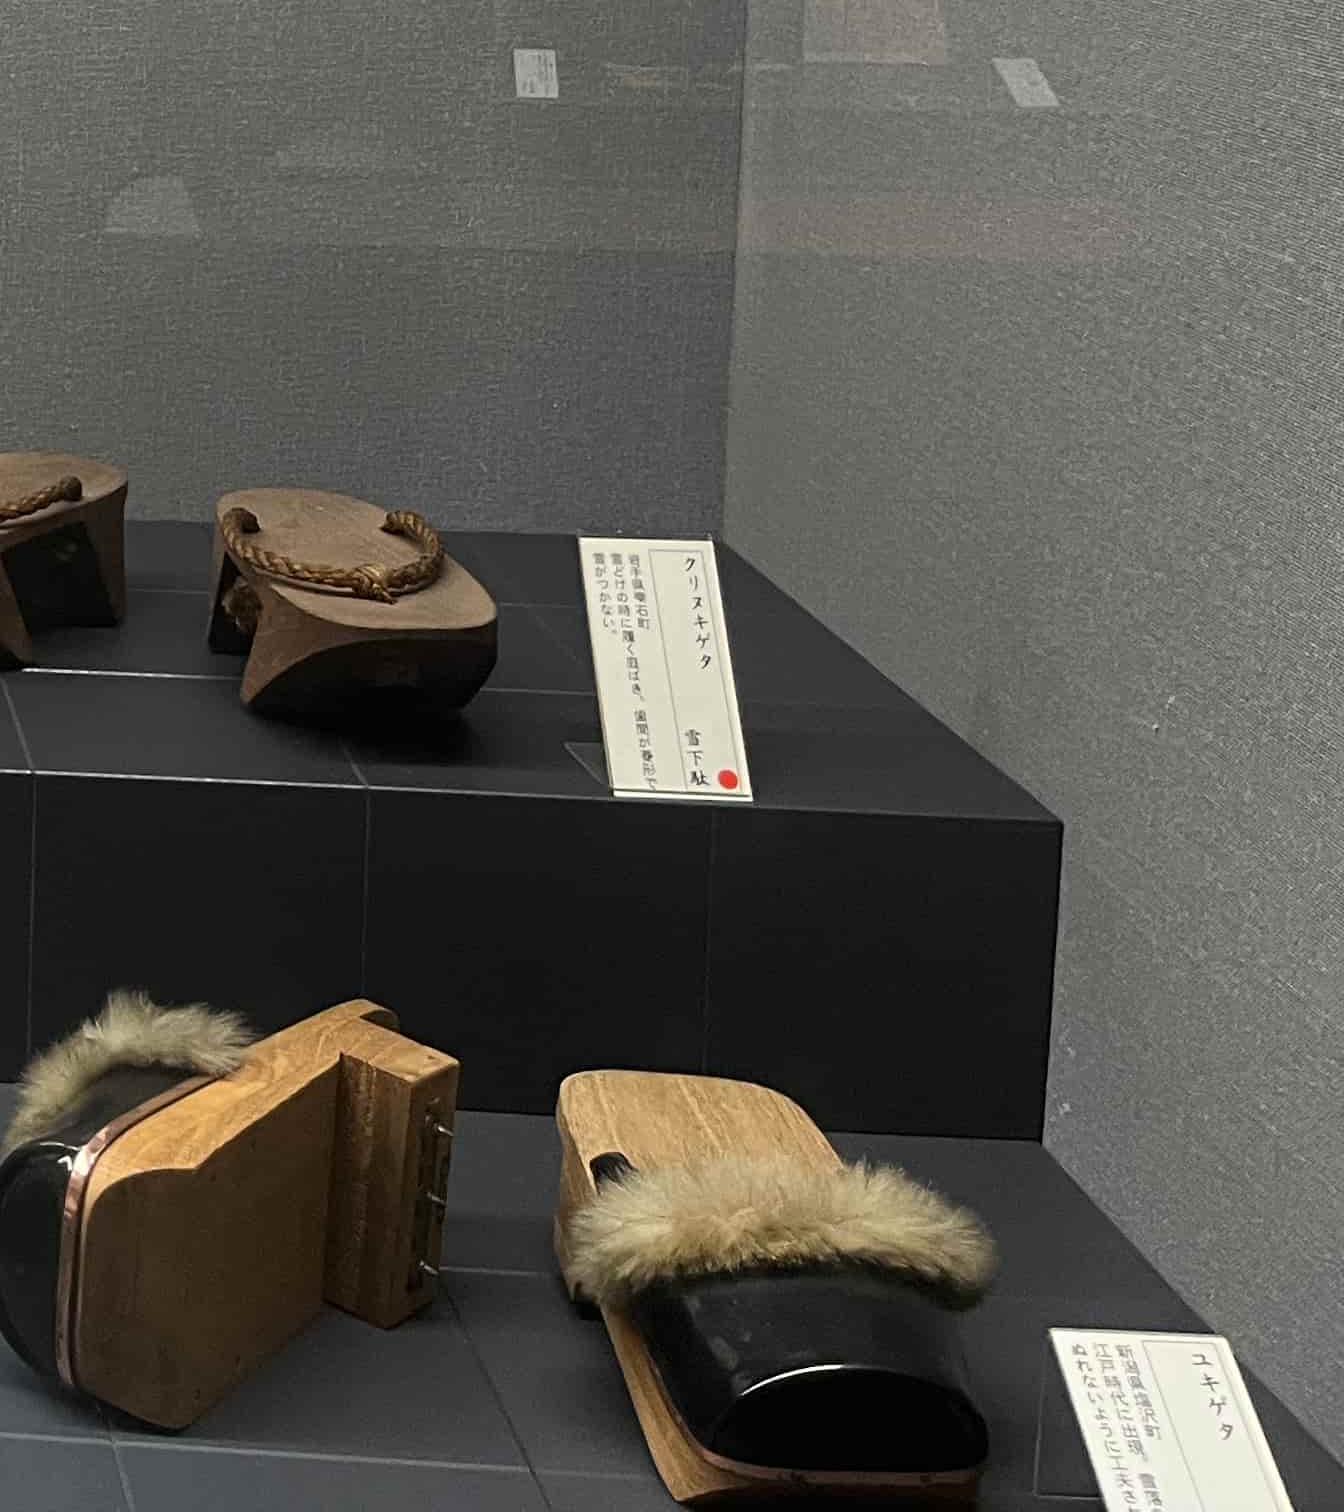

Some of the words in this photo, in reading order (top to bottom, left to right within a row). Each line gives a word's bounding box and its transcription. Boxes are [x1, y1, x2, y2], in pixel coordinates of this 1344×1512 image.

[683, 728, 711, 787] 雪下駄
[1191, 1353, 1233, 1441] ユキゲタ
